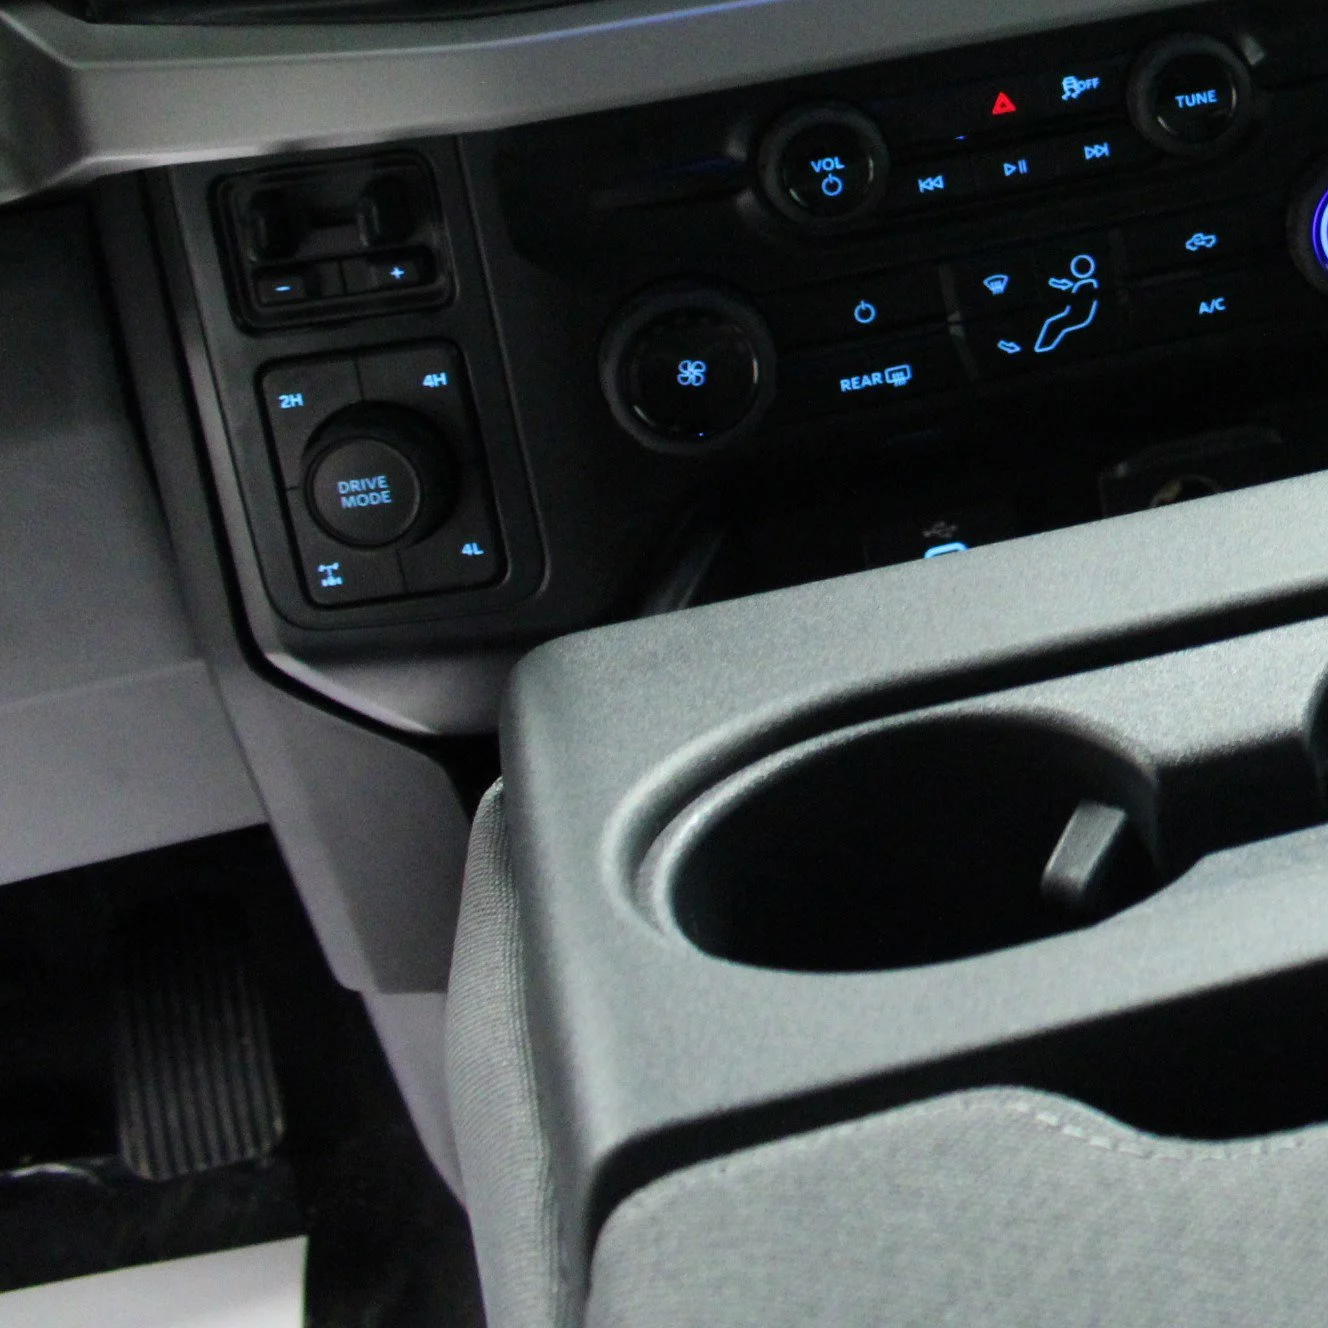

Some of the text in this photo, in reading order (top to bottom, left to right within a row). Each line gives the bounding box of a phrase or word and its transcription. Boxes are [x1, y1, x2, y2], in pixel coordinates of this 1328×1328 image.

[1077, 77, 1100, 92] OFF
[1175, 89, 1218, 109] TUNE
[811, 156, 845, 172] VOL
[1198, 295, 1227, 315] A/C
[422, 372, 448, 389] 4H
[840, 371, 883, 393] REAR
[278, 393, 304, 409] 2H
[338, 476, 389, 495] DRIVE
[341, 490, 393, 509] MODE
[461, 541, 485, 558] 4L
